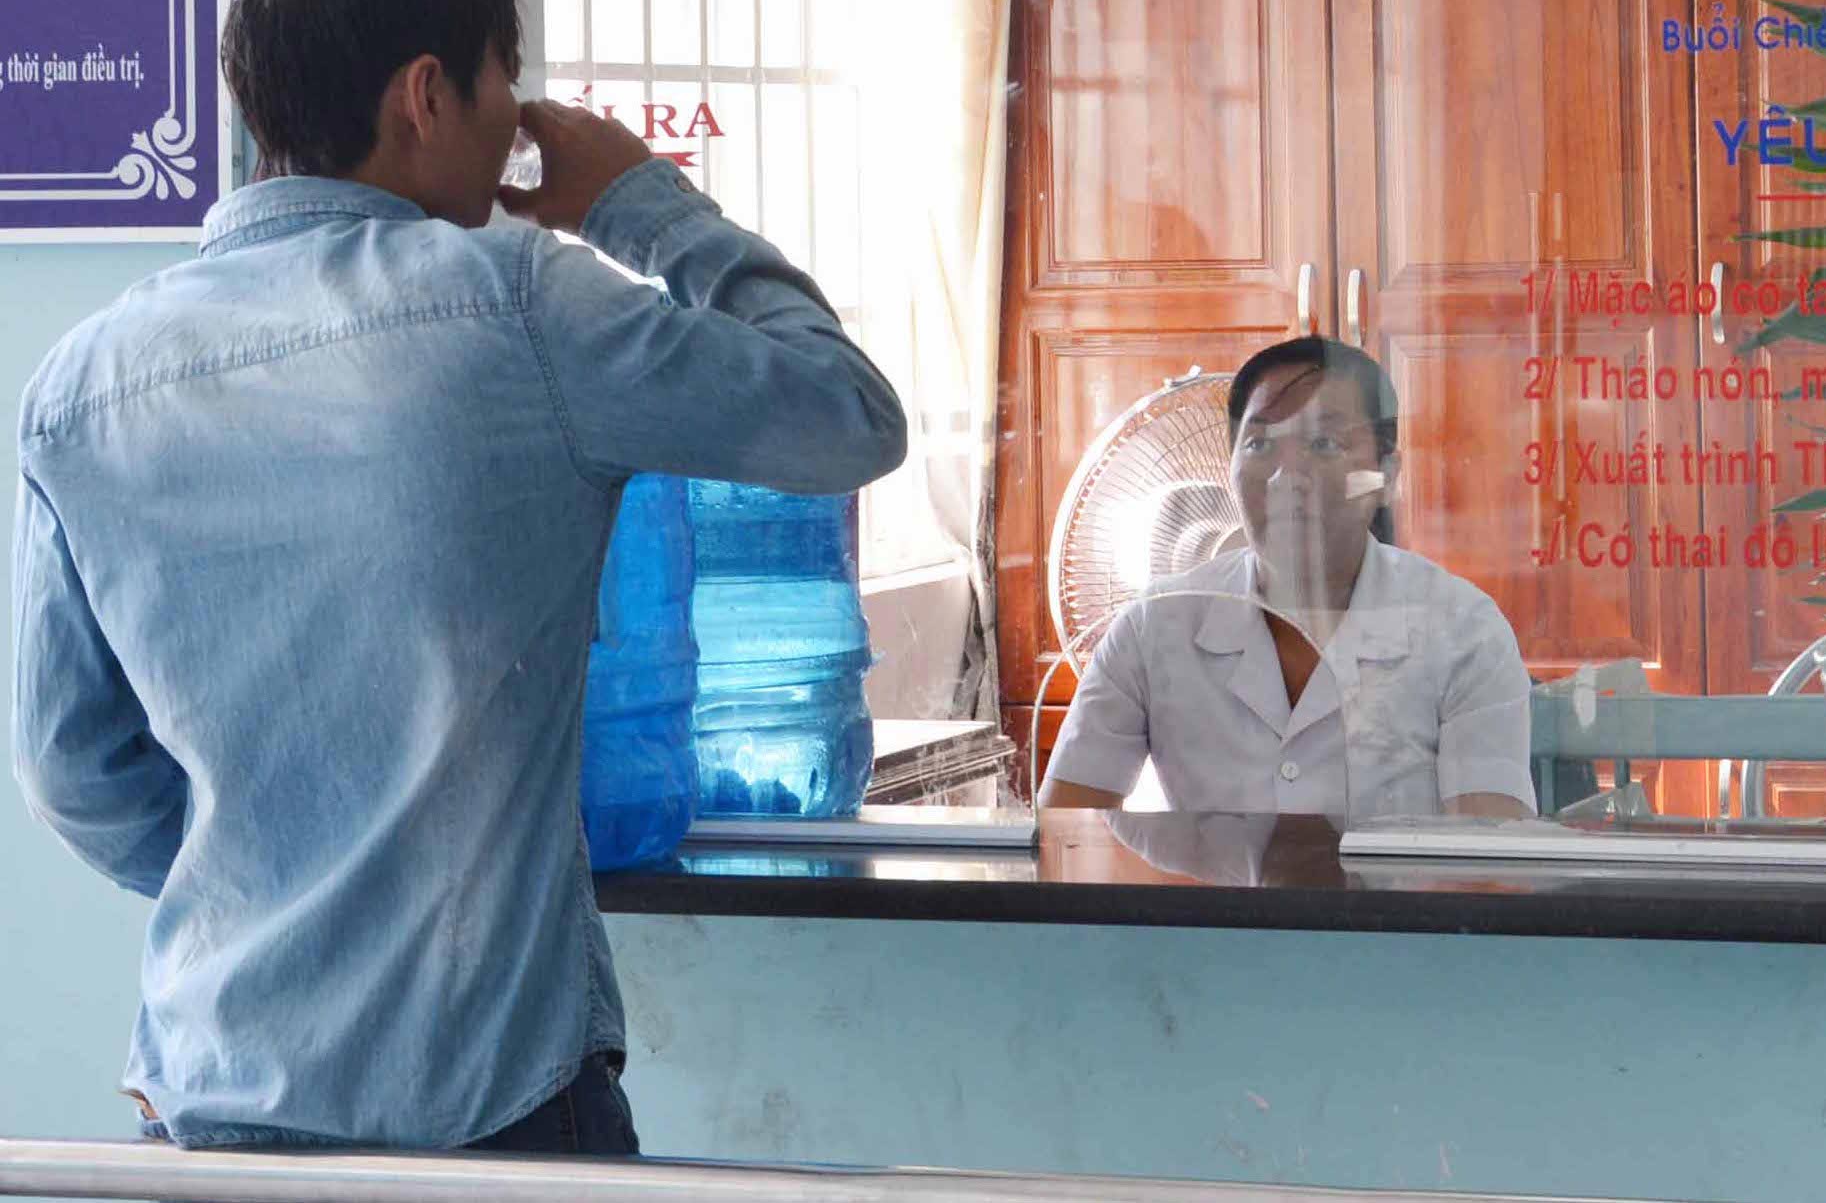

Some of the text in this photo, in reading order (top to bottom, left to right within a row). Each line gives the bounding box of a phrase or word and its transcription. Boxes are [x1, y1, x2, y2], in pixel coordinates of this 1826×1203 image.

[1662, 2, 1742, 53] Buổi
[8, 52, 39, 82] thời
[44, 53, 77, 90] gian
[82, 42, 115, 81] điều
[120, 51, 144, 89] trị.
[642, 101, 726, 140] RA
[1520, 268, 1556, 316] 1/
[1567, 270, 1652, 330] Mặc
[1666, 269, 1717, 316] áo
[1731, 271, 1784, 316] có
[1523, 354, 1562, 401] 2/
[1573, 354, 1679, 401] Tháo
[1523, 439, 1560, 487] 3/
[1573, 430, 1666, 487] Xuất
[1680, 440, 1778, 487] trình
[1577, 519, 1635, 568] Có
